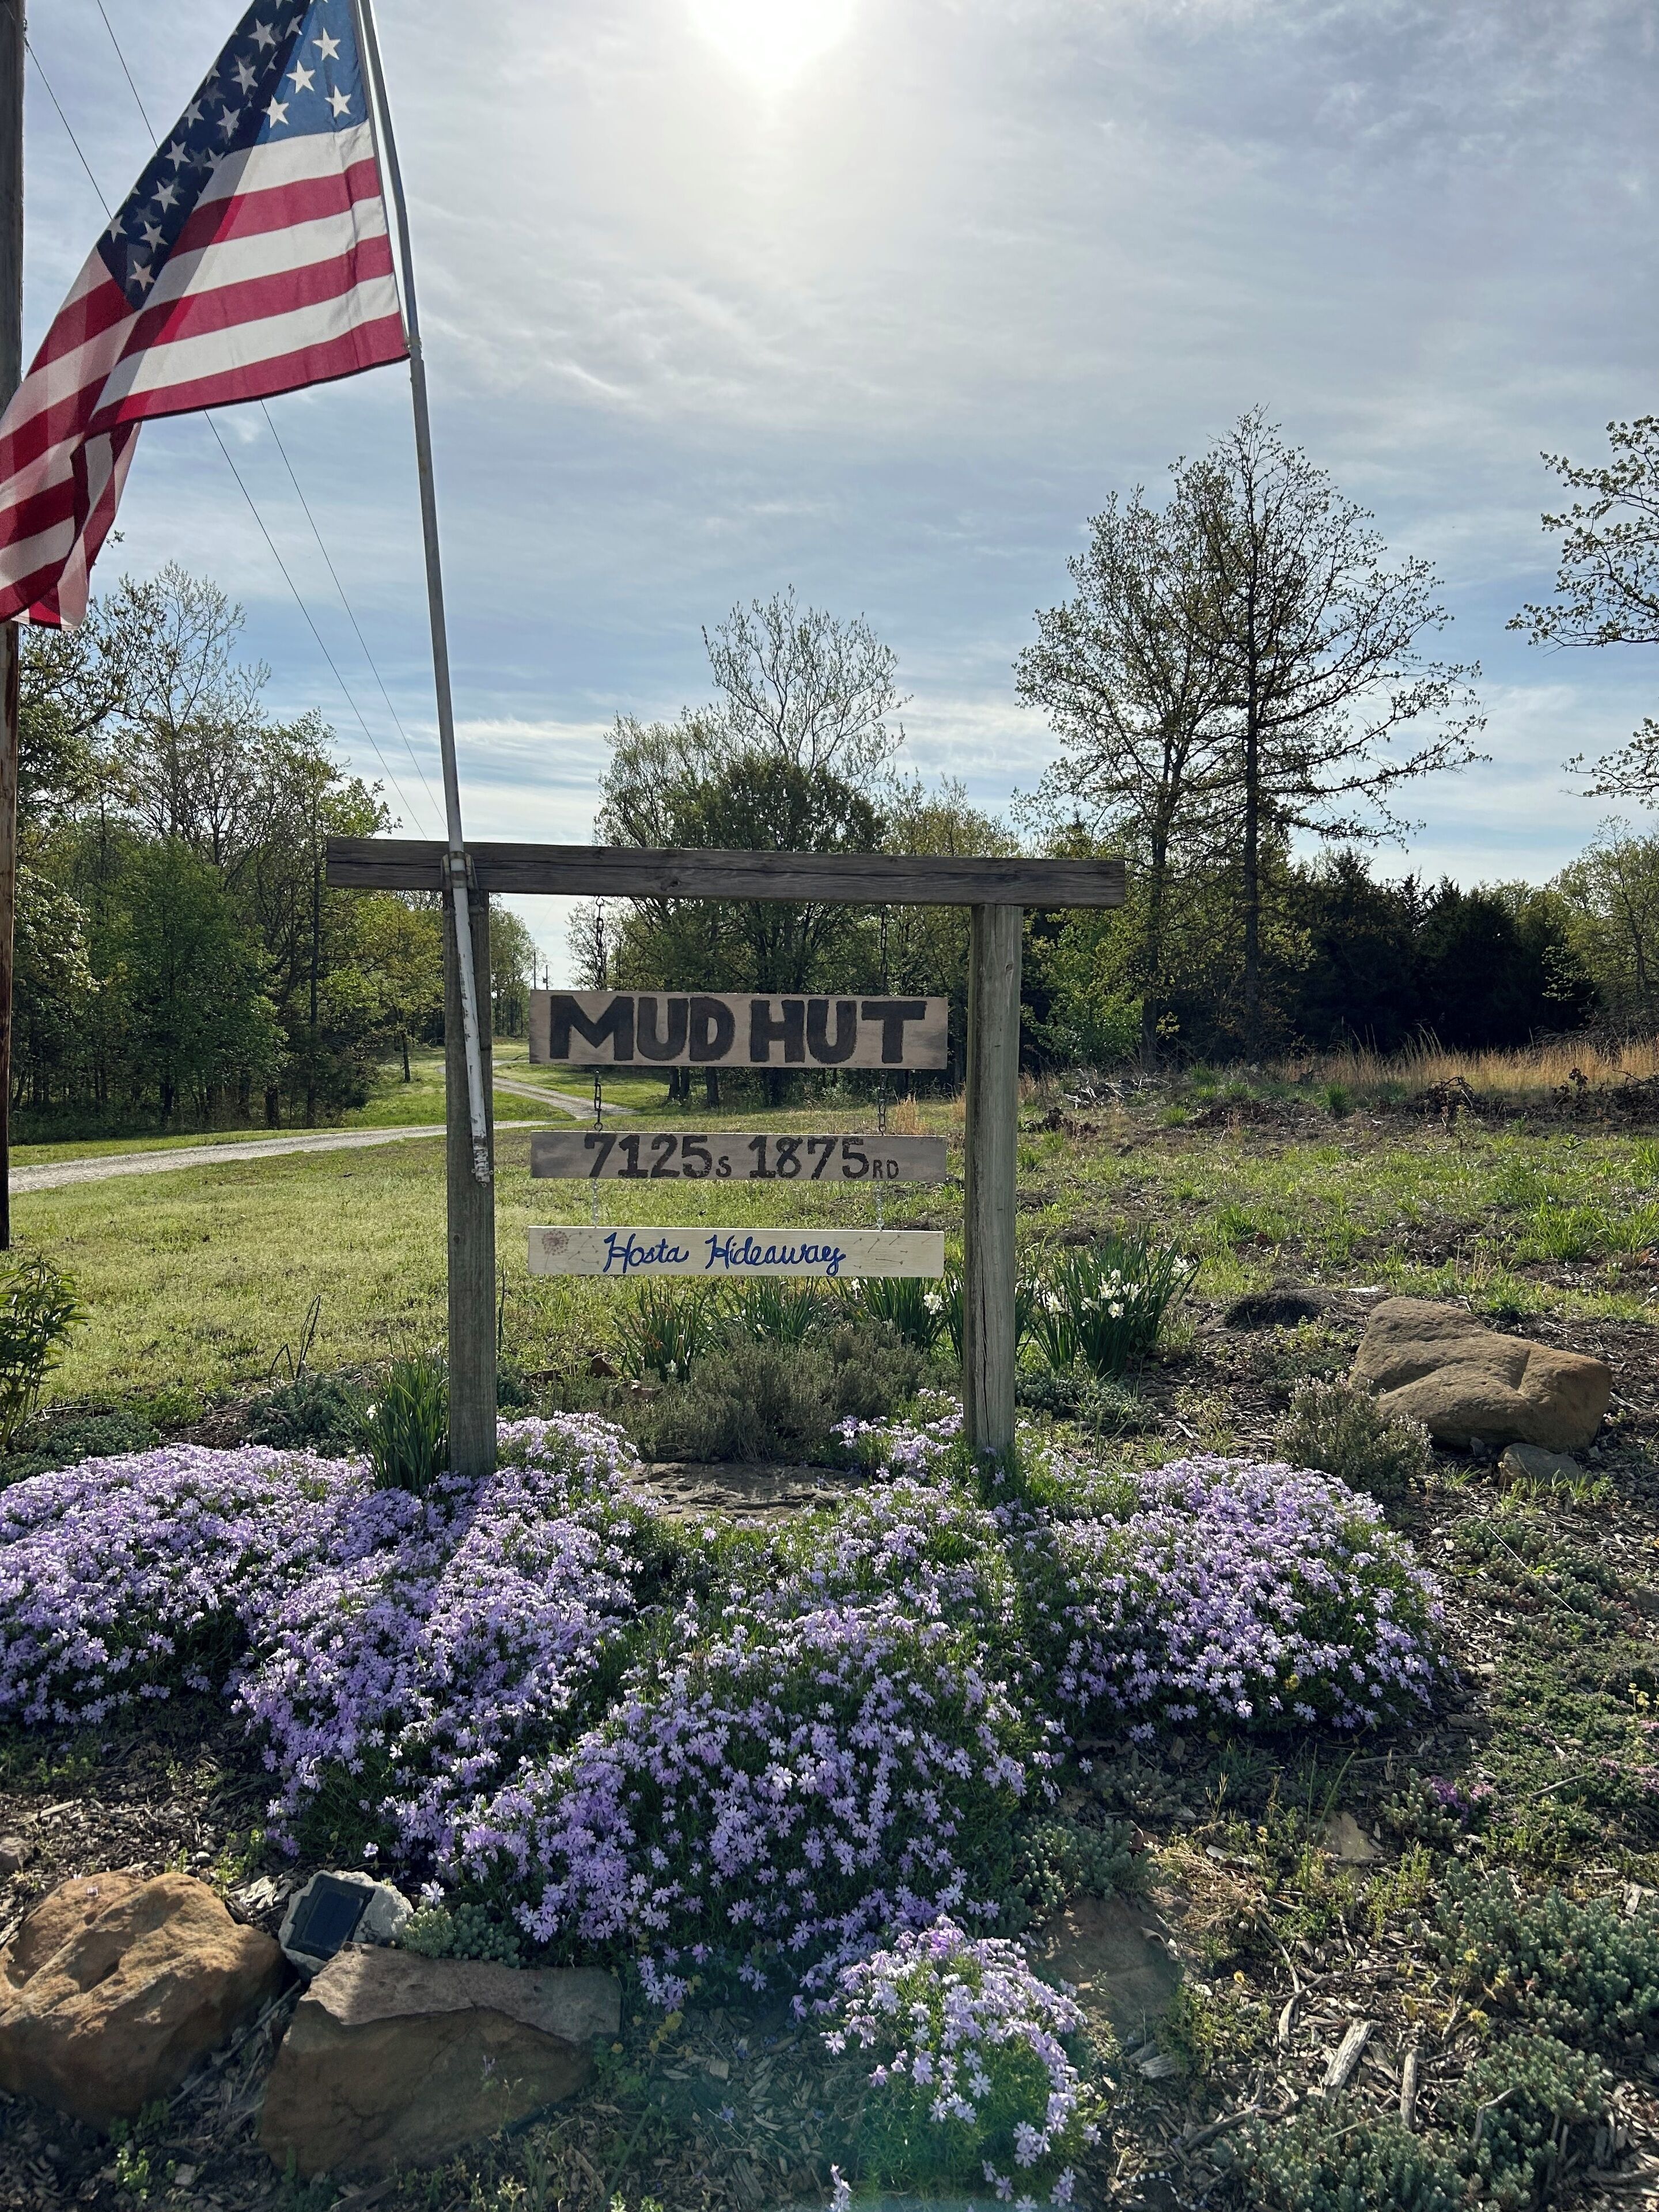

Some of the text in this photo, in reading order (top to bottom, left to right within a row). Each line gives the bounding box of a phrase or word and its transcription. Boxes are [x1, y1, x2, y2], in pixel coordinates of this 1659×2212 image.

[550, 995, 926, 1064] MUD HUT
[603, 1232, 847, 1277] Hosta Hideaway
